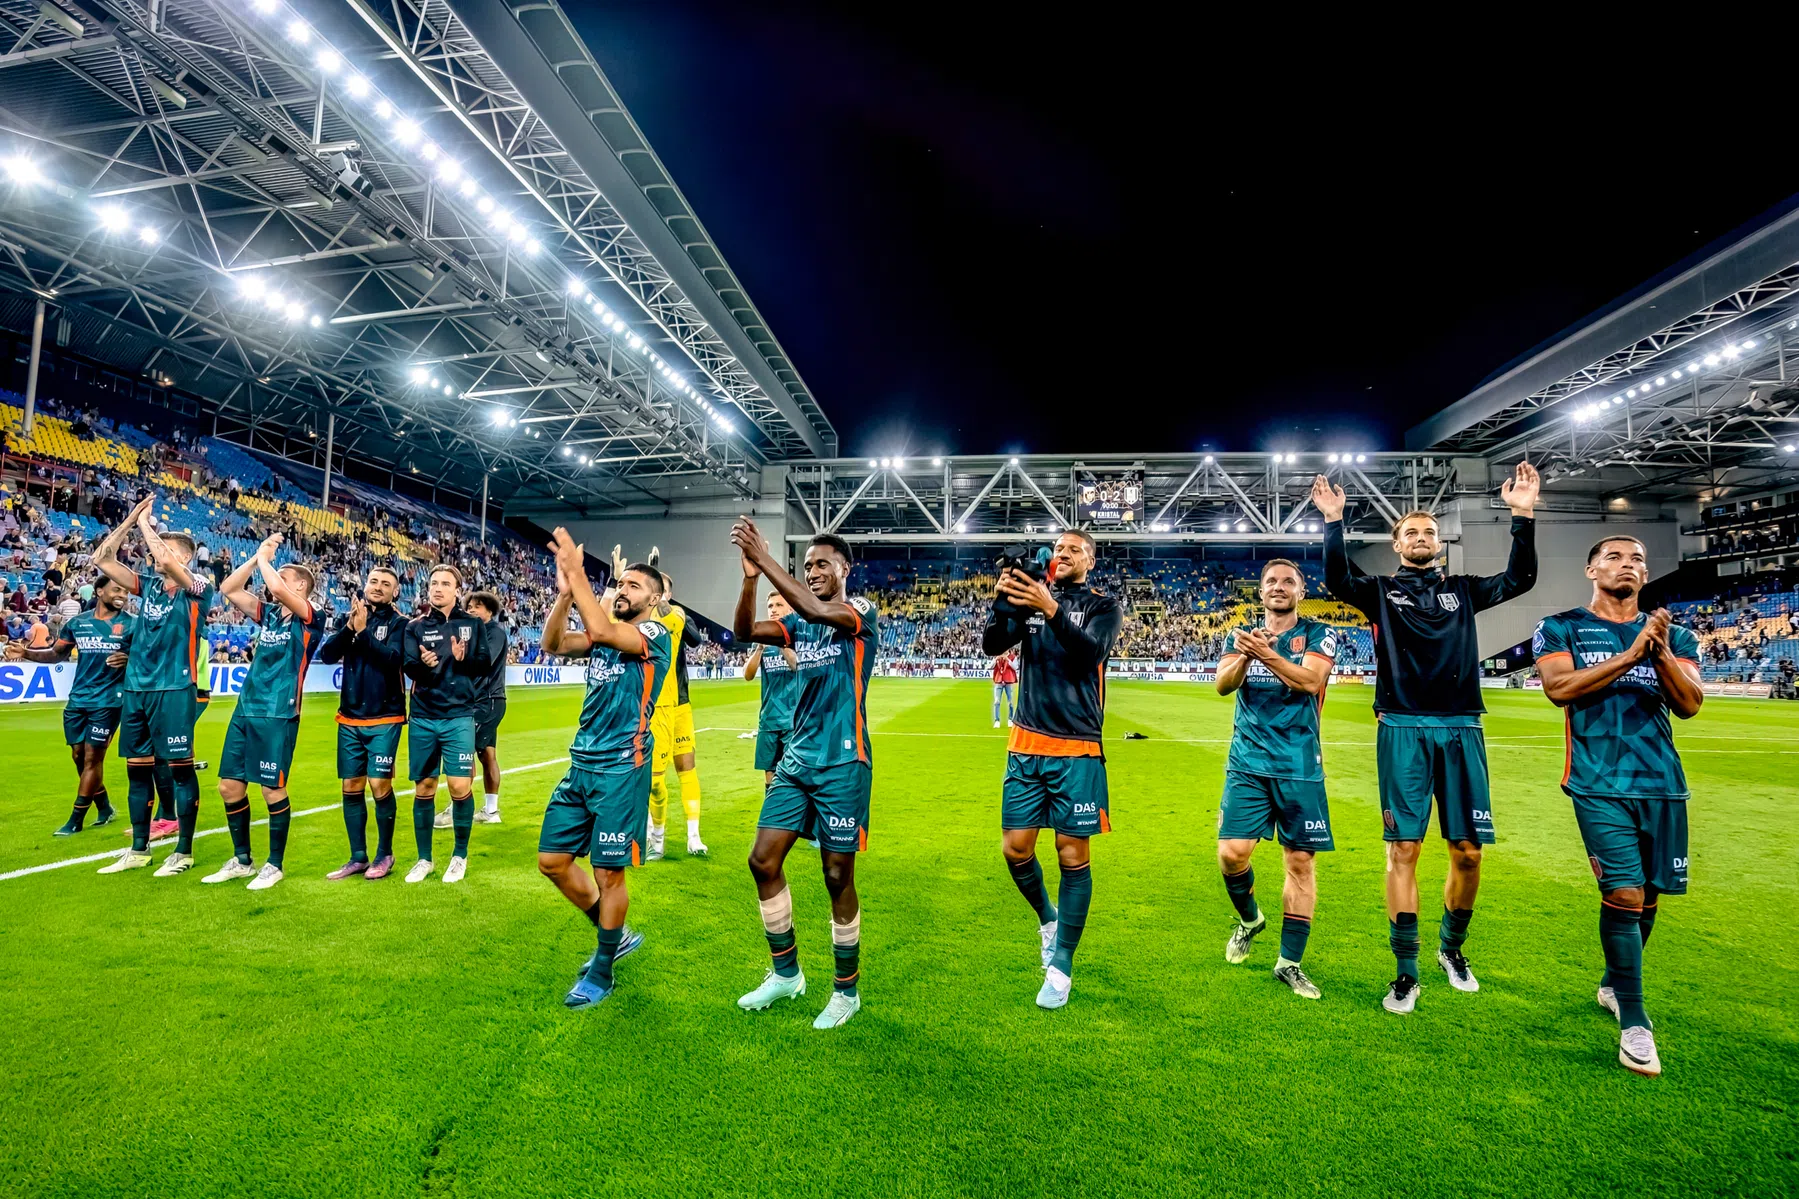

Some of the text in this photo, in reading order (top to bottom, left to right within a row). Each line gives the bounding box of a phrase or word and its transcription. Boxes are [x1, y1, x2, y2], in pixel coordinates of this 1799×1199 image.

[966, 669, 990, 677] WISA
[1120, 662, 1205, 673] NOW AND
[532, 668, 561, 683] WISA
[91, 726, 110, 735] DAS
[167, 735, 188, 744] DAS
[676, 736, 690, 744] DAS
[260, 760, 277, 770] DAS
[376, 755, 393, 764] DAS
[1074, 802, 1096, 813] DAS
[1472, 809, 1492, 820] DA
[829, 816, 856, 828] DAS
[1304, 819, 1326, 830] DAS
[599, 832, 626, 843] DAS
[1673, 857, 1688, 869] DA
